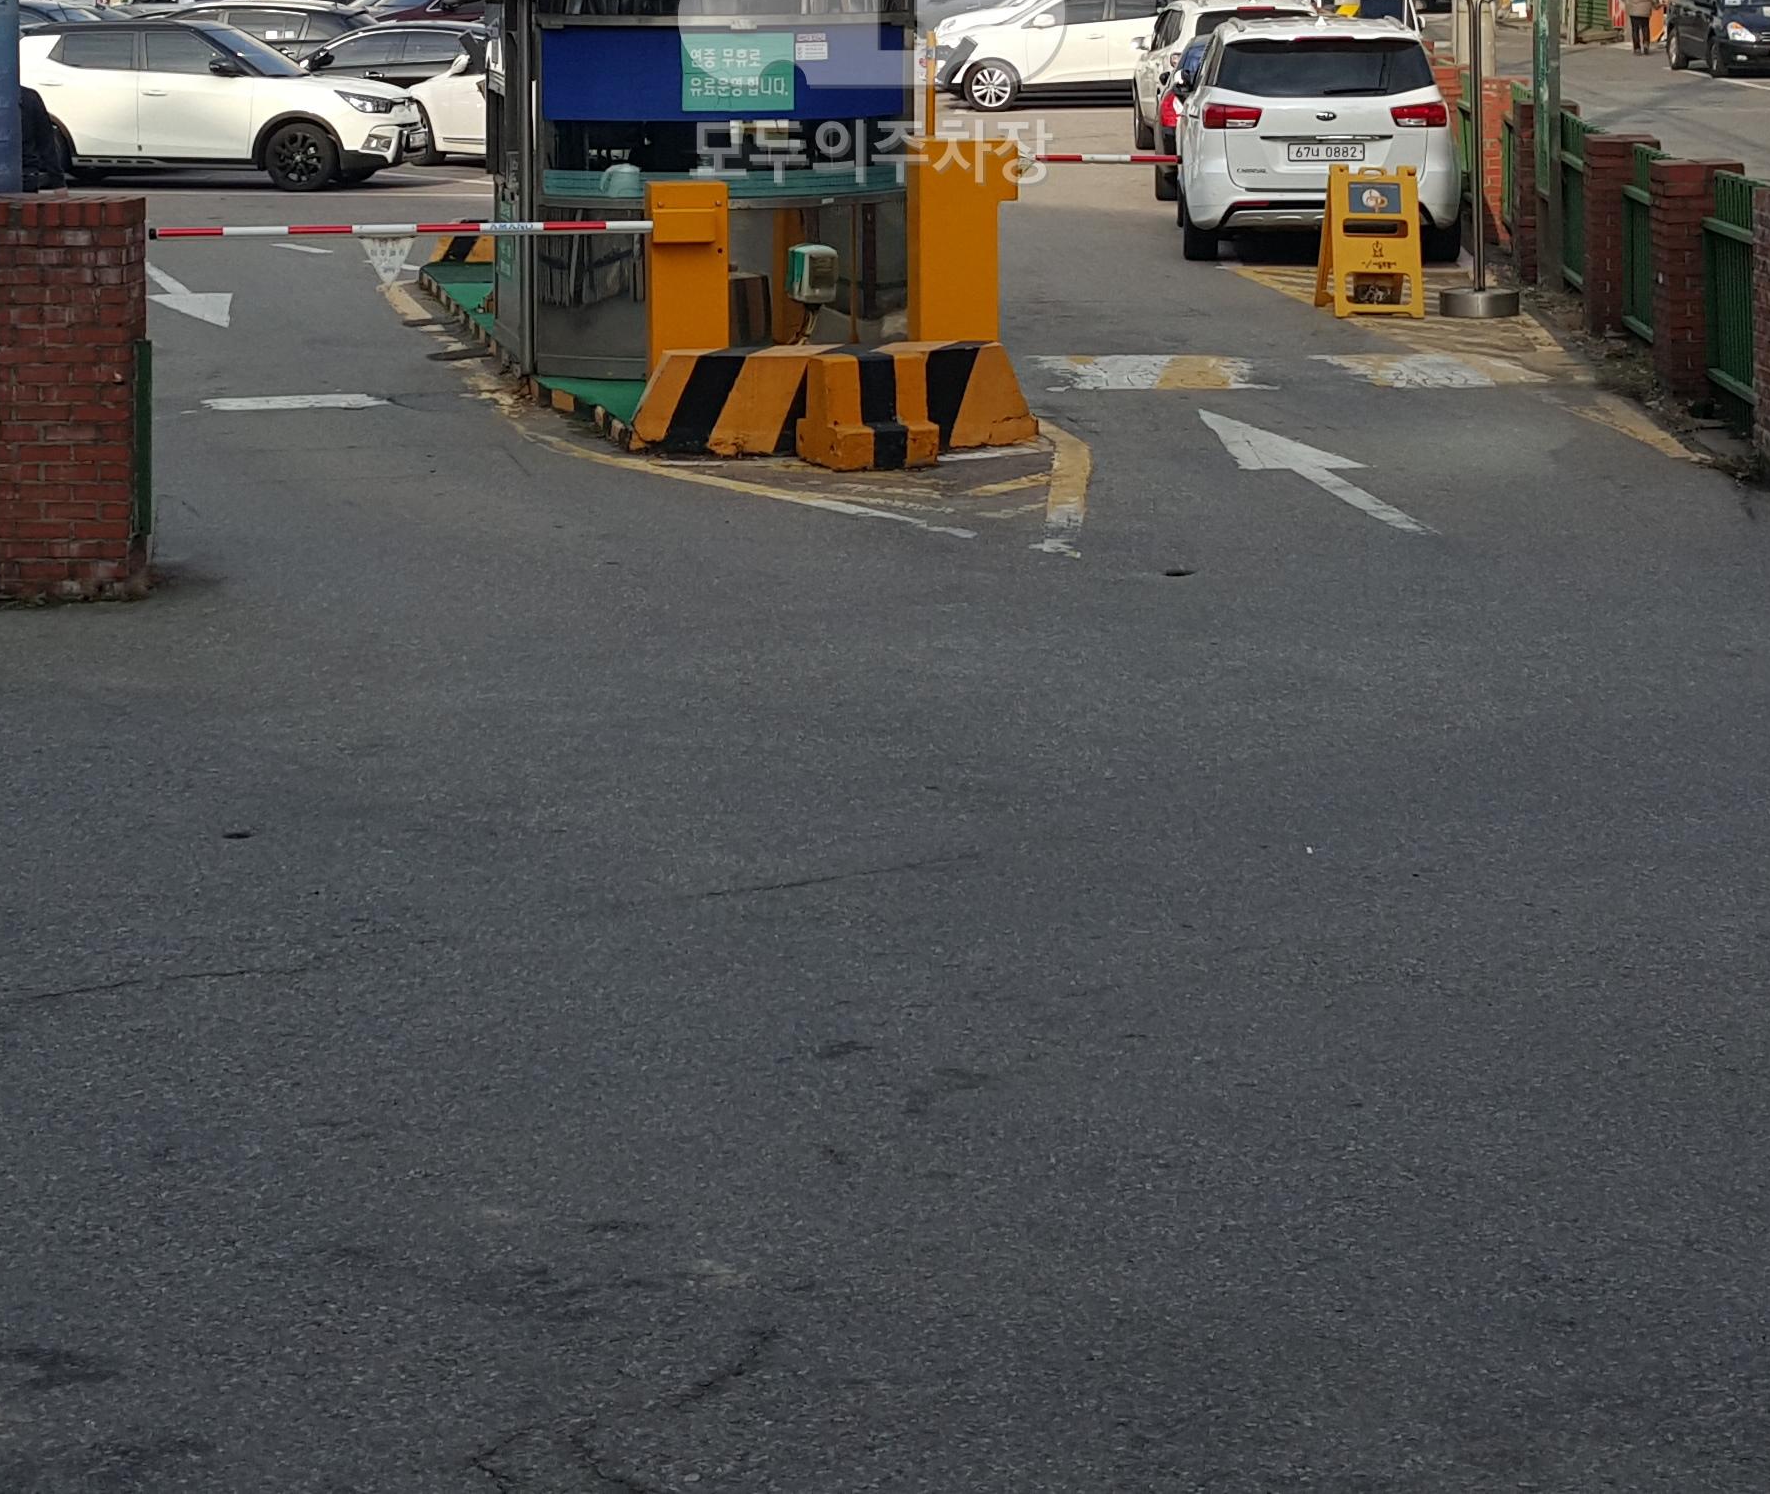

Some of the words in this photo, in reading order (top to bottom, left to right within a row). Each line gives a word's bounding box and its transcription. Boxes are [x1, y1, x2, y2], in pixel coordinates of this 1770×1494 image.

[689, 47, 716, 69] 연중
[721, 47, 762, 68] 무휴로
[1325, 146, 1358, 158] 0882
[489, 222, 534, 231] AMANO
